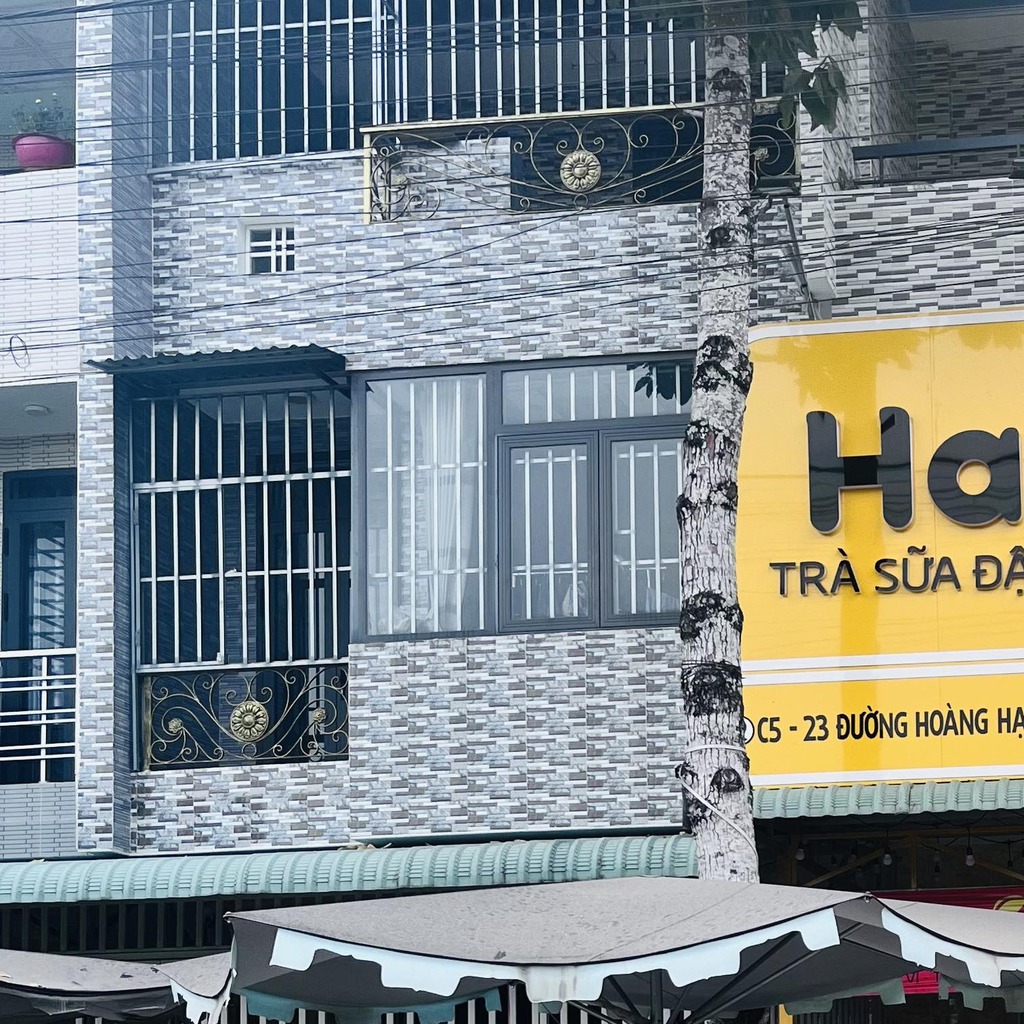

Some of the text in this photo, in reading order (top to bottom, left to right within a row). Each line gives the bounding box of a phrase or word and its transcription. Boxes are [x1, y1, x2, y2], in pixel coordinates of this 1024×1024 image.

[769, 547, 861, 597] TRÀ
[874, 545, 962, 595] SỮA
[757, 716, 782, 743] C5
[803, 714, 829, 742] 23
[836, 705, 908, 740] ĐƯỜNG
[915, 702, 988, 738] HOÀNG
